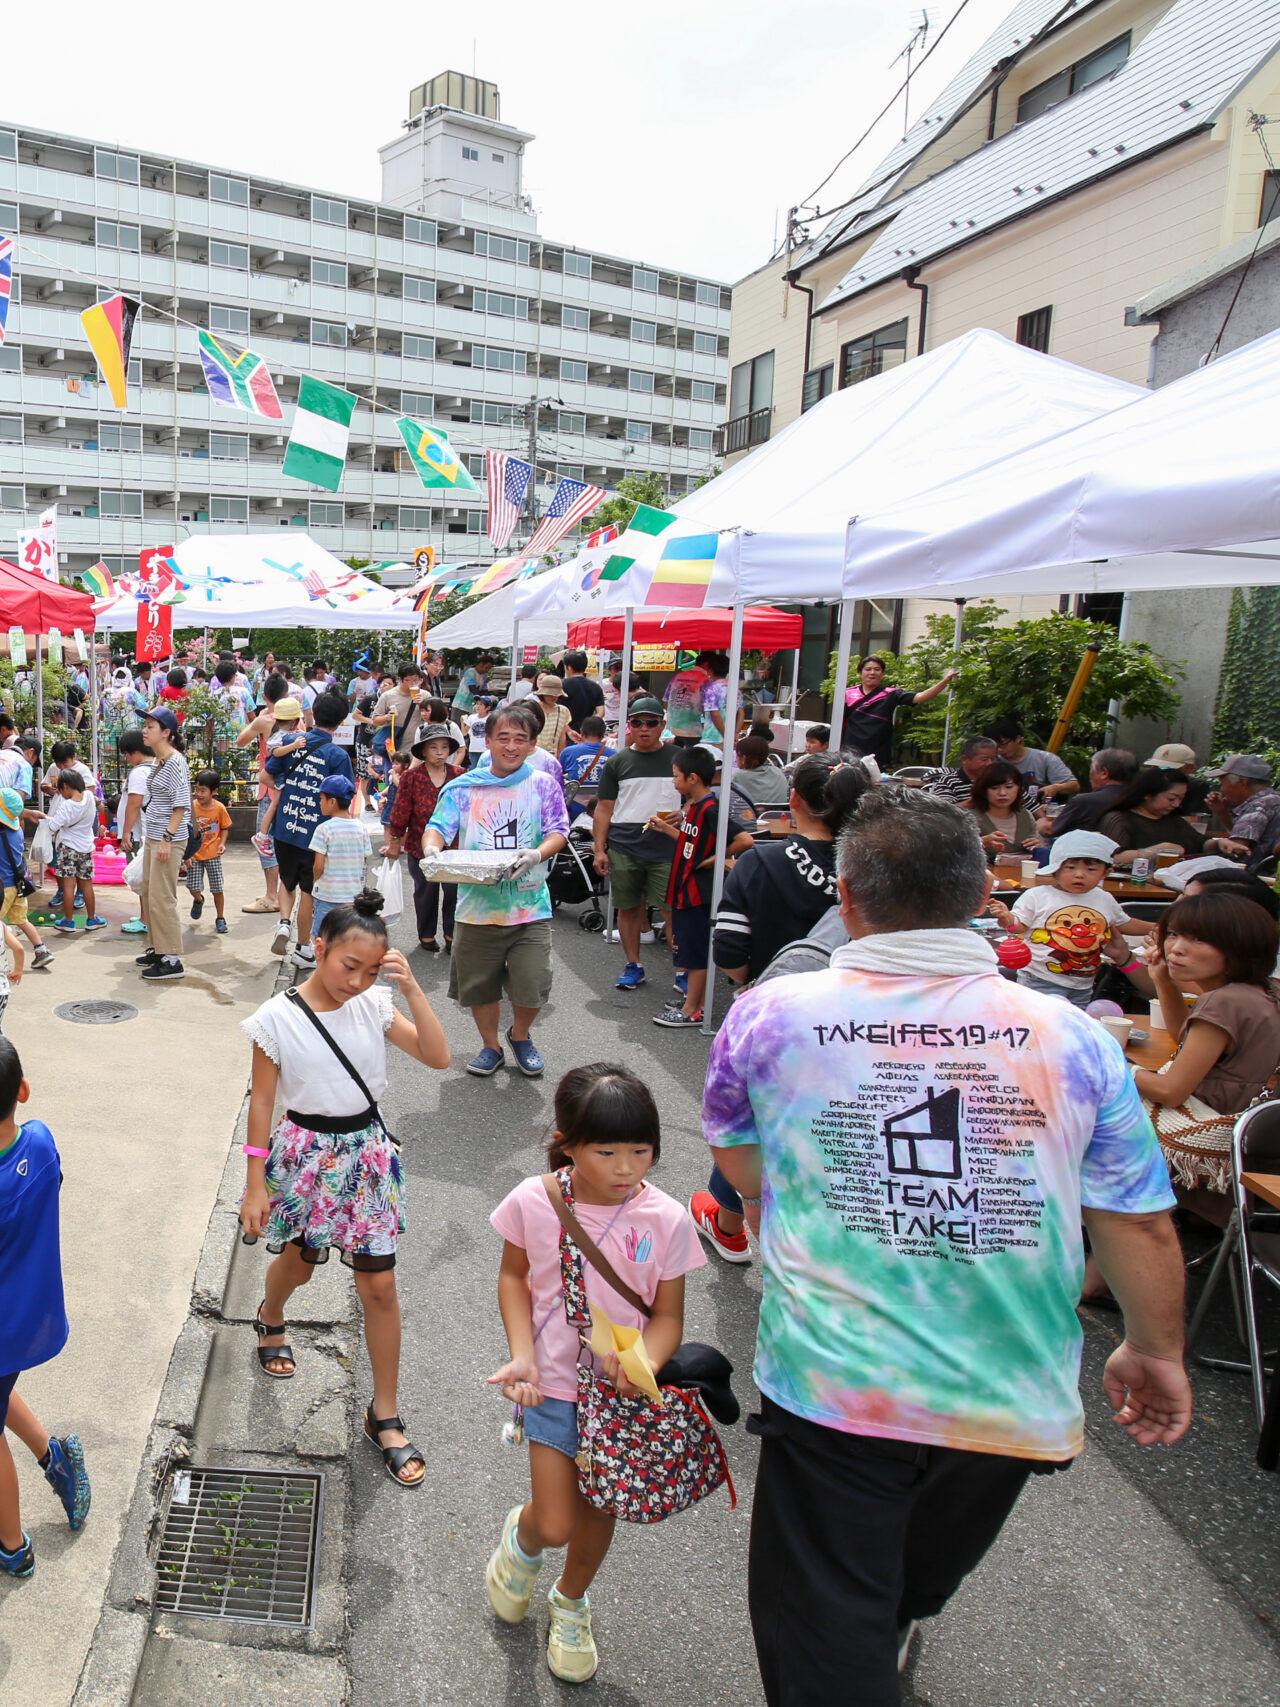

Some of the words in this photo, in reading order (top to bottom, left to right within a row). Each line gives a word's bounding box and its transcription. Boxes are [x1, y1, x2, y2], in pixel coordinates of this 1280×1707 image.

[970, 1085, 1020, 1094] AVELCO
[829, 1100, 888, 1111] DESIGNLIFE
[971, 1126, 1005, 1135] LIXIL
[818, 1138, 858, 1149] MATERIAL
[968, 1157, 998, 1167] MOC
[970, 1167, 997, 1175] NKC
[879, 1178, 980, 1213] TEAM
[885, 1209, 977, 1247] TAKEI
